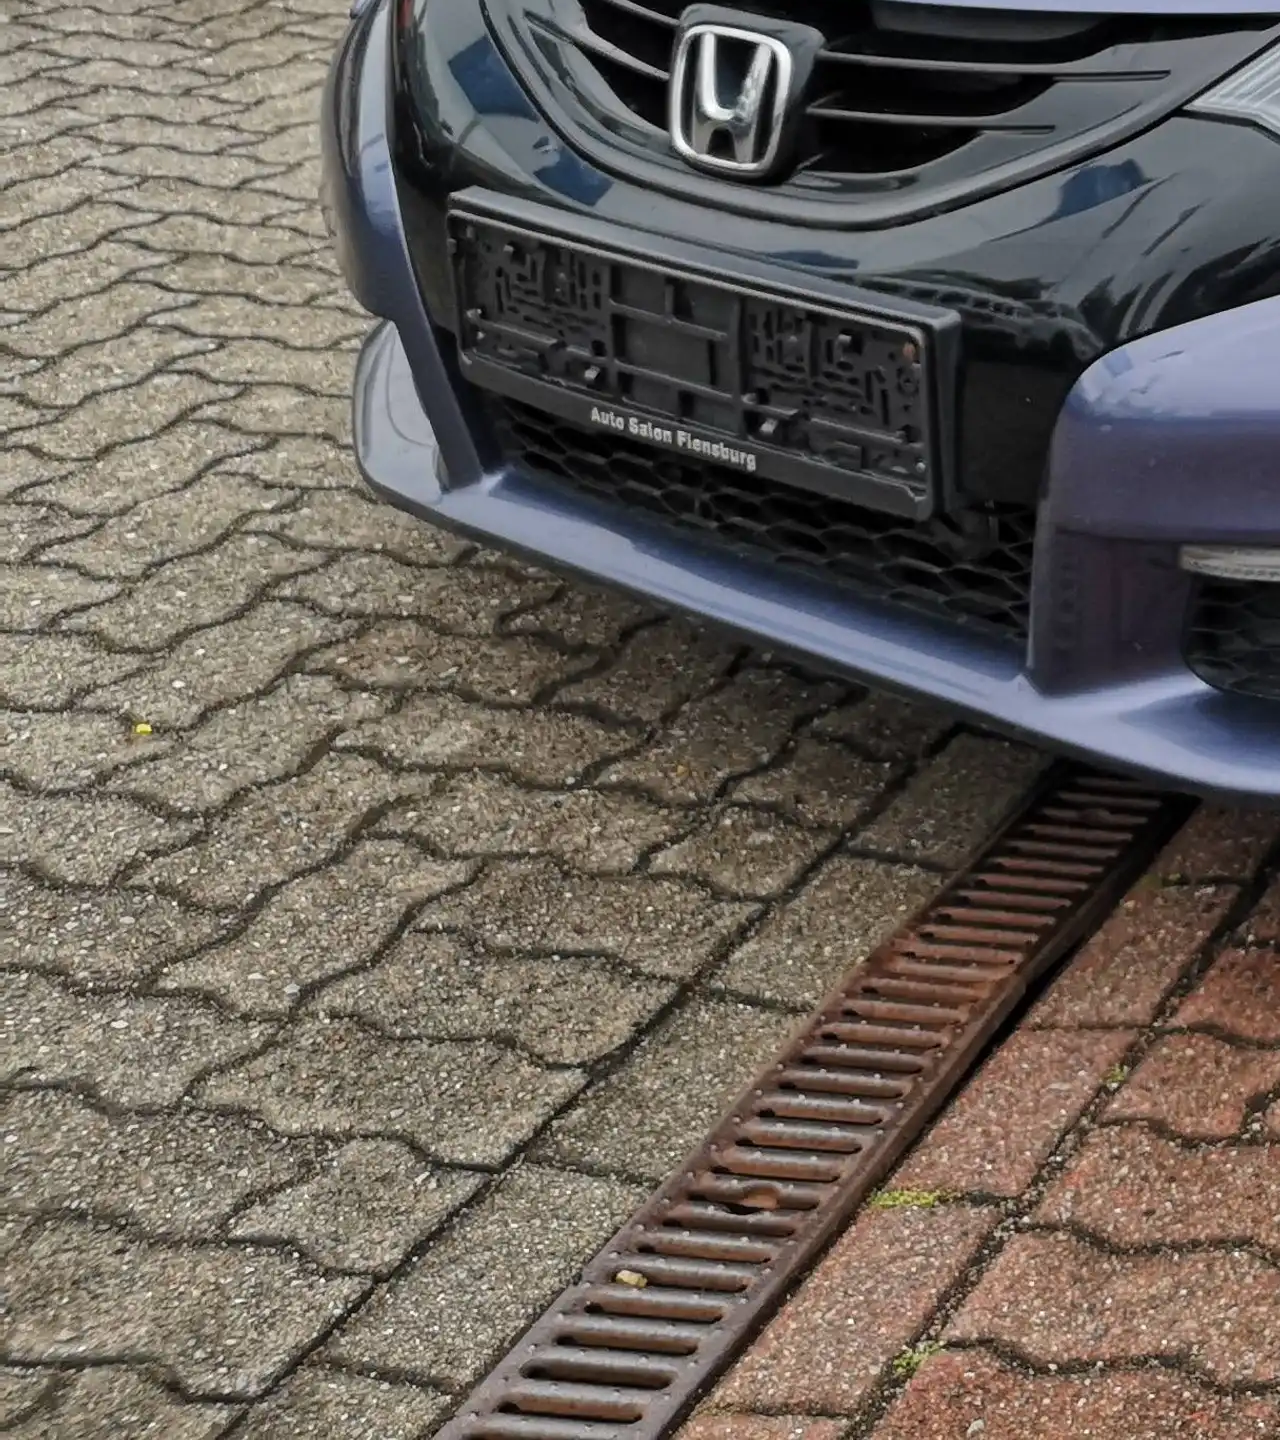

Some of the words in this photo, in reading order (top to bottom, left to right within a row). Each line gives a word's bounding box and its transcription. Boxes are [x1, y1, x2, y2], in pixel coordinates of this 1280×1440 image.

[591, 407, 625, 431] Auto
[628, 417, 673, 444] Salon
[676, 430, 756, 472] Flensburg
